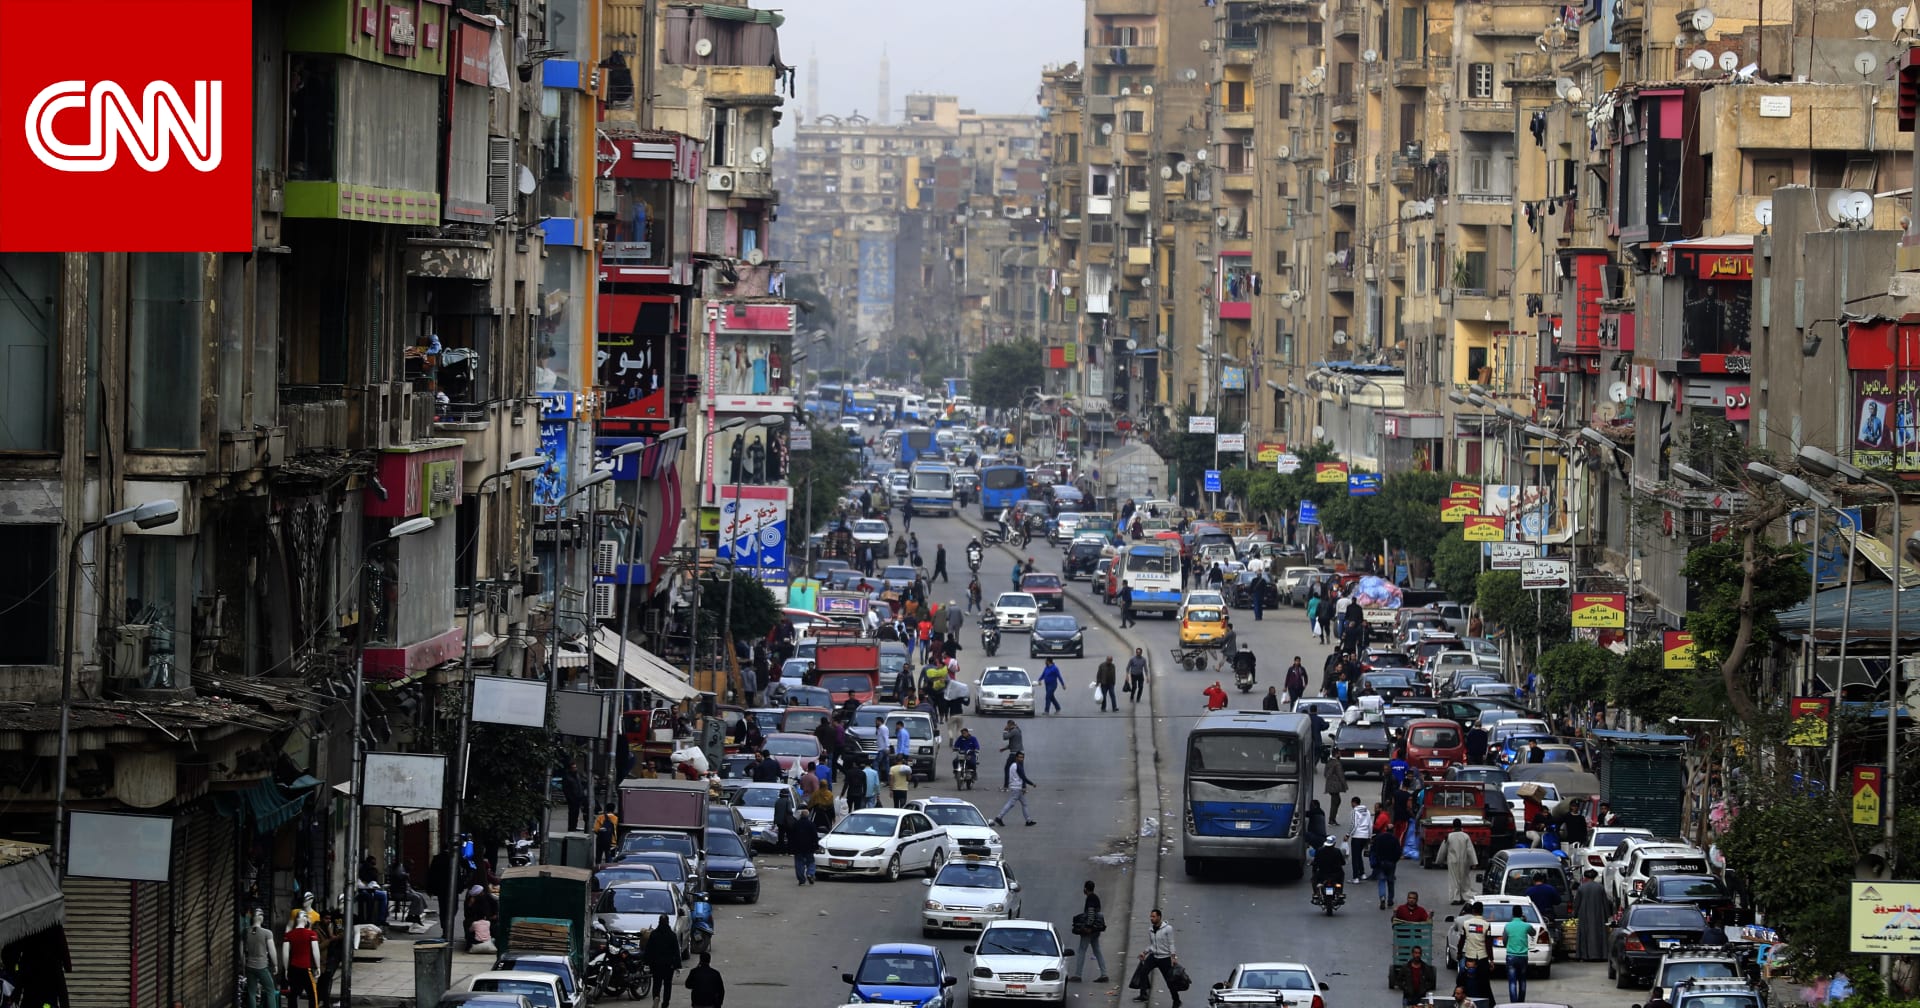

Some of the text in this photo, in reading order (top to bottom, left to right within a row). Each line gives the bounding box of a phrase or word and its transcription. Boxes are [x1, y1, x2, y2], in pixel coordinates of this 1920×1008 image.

[1710, 256, 1742, 278] الشام
[615, 339, 652, 379] أبو
[1493, 550, 1512, 558] راغب
[1523, 568, 1544, 576] راغب
[1578, 611, 1618, 621] العروسة
[1872, 904, 1905, 915] الشروق
